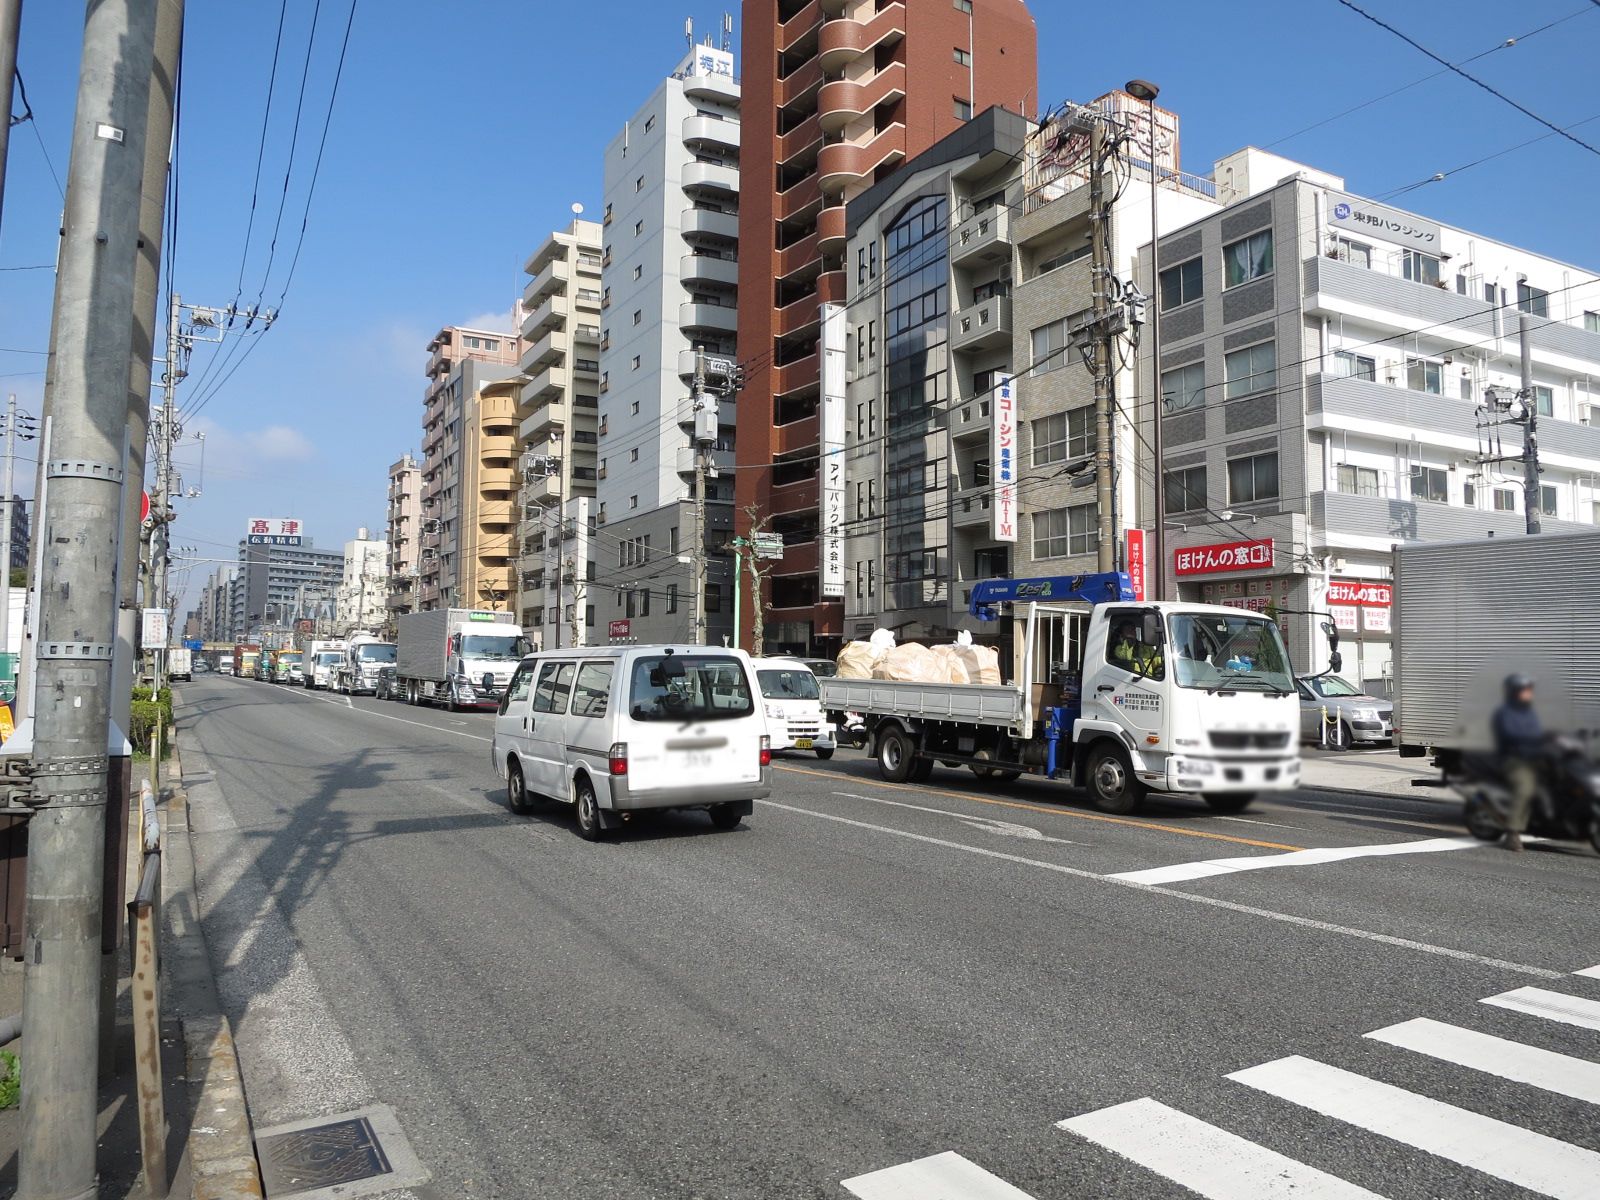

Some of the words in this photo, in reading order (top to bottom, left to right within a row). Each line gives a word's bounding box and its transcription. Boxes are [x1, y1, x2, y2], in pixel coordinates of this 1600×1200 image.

[1353, 211, 1435, 241] 東邦ハウジング
[1132, 543, 1142, 593] ほけんの窓口
[1177, 544, 1266, 571] ほけんの窓口
[1329, 585, 1387, 603] ほけんの窓口
